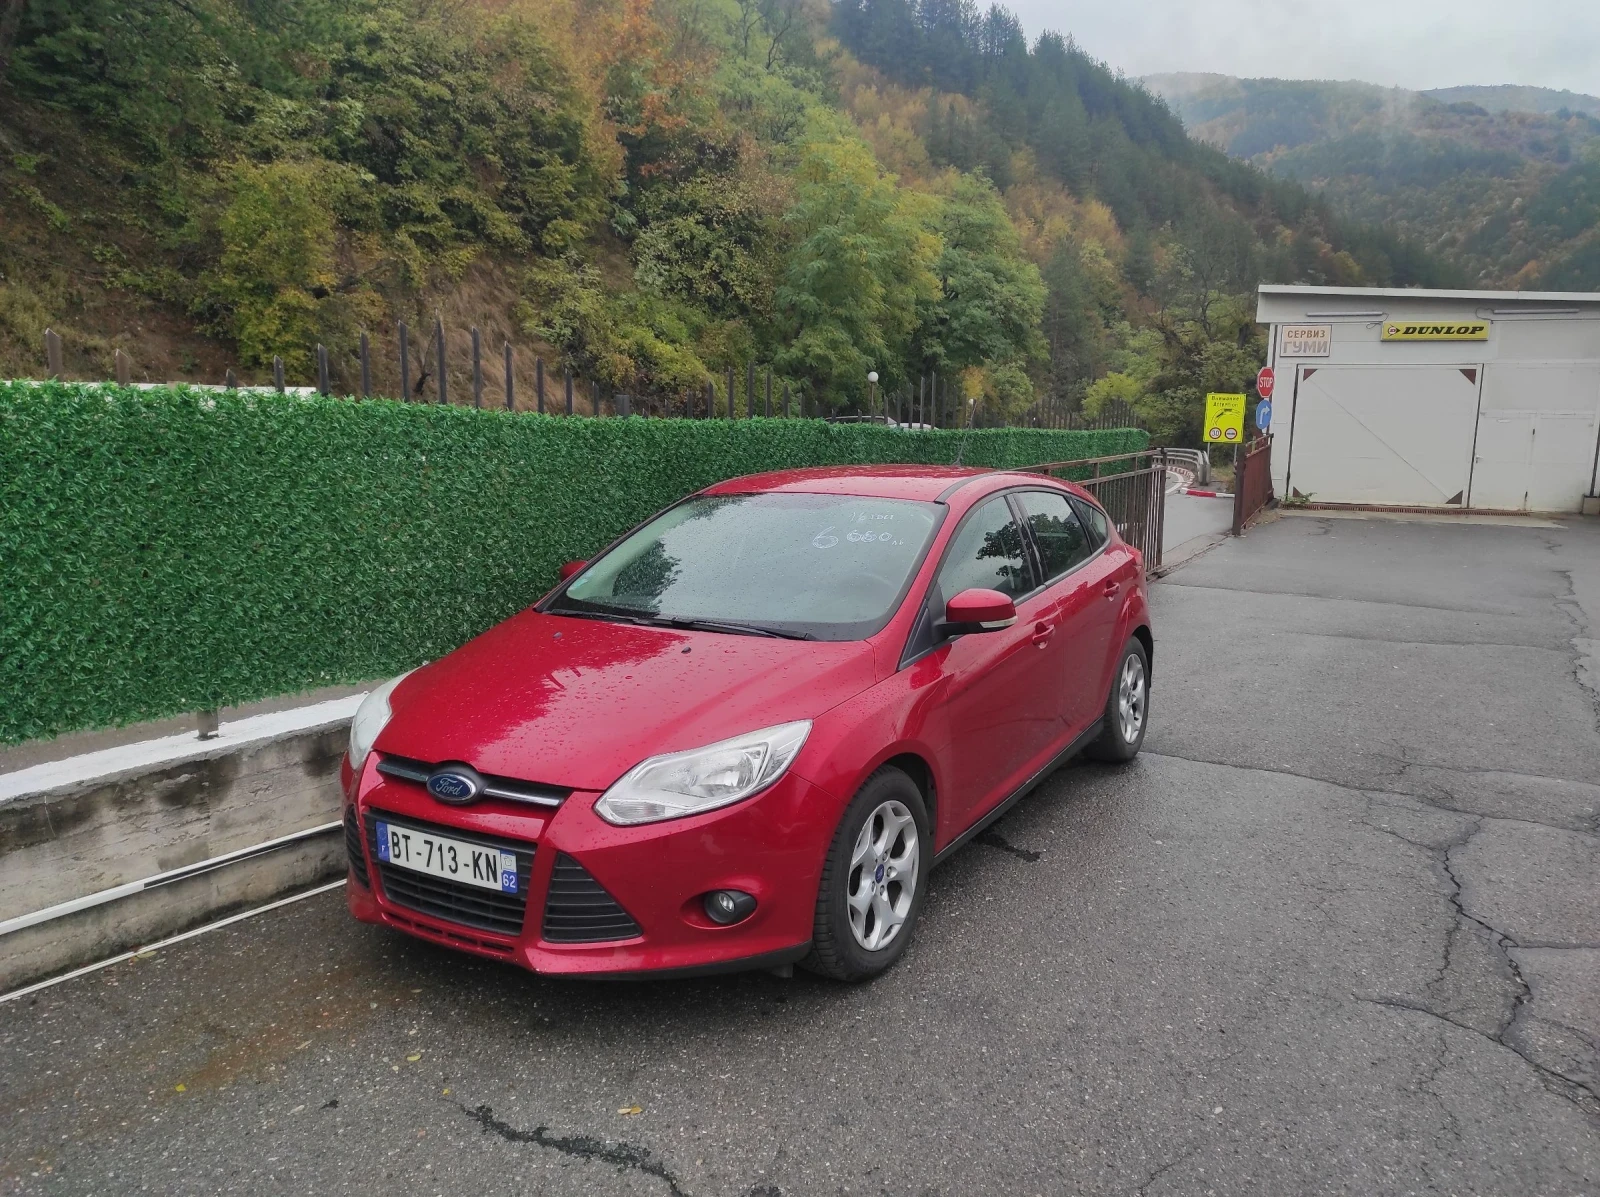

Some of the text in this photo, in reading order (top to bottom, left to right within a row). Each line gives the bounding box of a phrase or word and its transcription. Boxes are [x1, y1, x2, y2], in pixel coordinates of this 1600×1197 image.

[1287, 329, 1326, 339] СЕРВИЗ
[1402, 326, 1485, 335] DUNLOP
[1283, 341, 1328, 354] ГУМИ
[1259, 376, 1274, 388] STOP
[1211, 429, 1220, 437] 30
[812, 525, 839, 549] 6
[435, 777, 462, 796] Ford
[381, 845, 386, 853] F
[391, 831, 498, 883] BT-713-KN
[502, 873, 517, 889] 62
